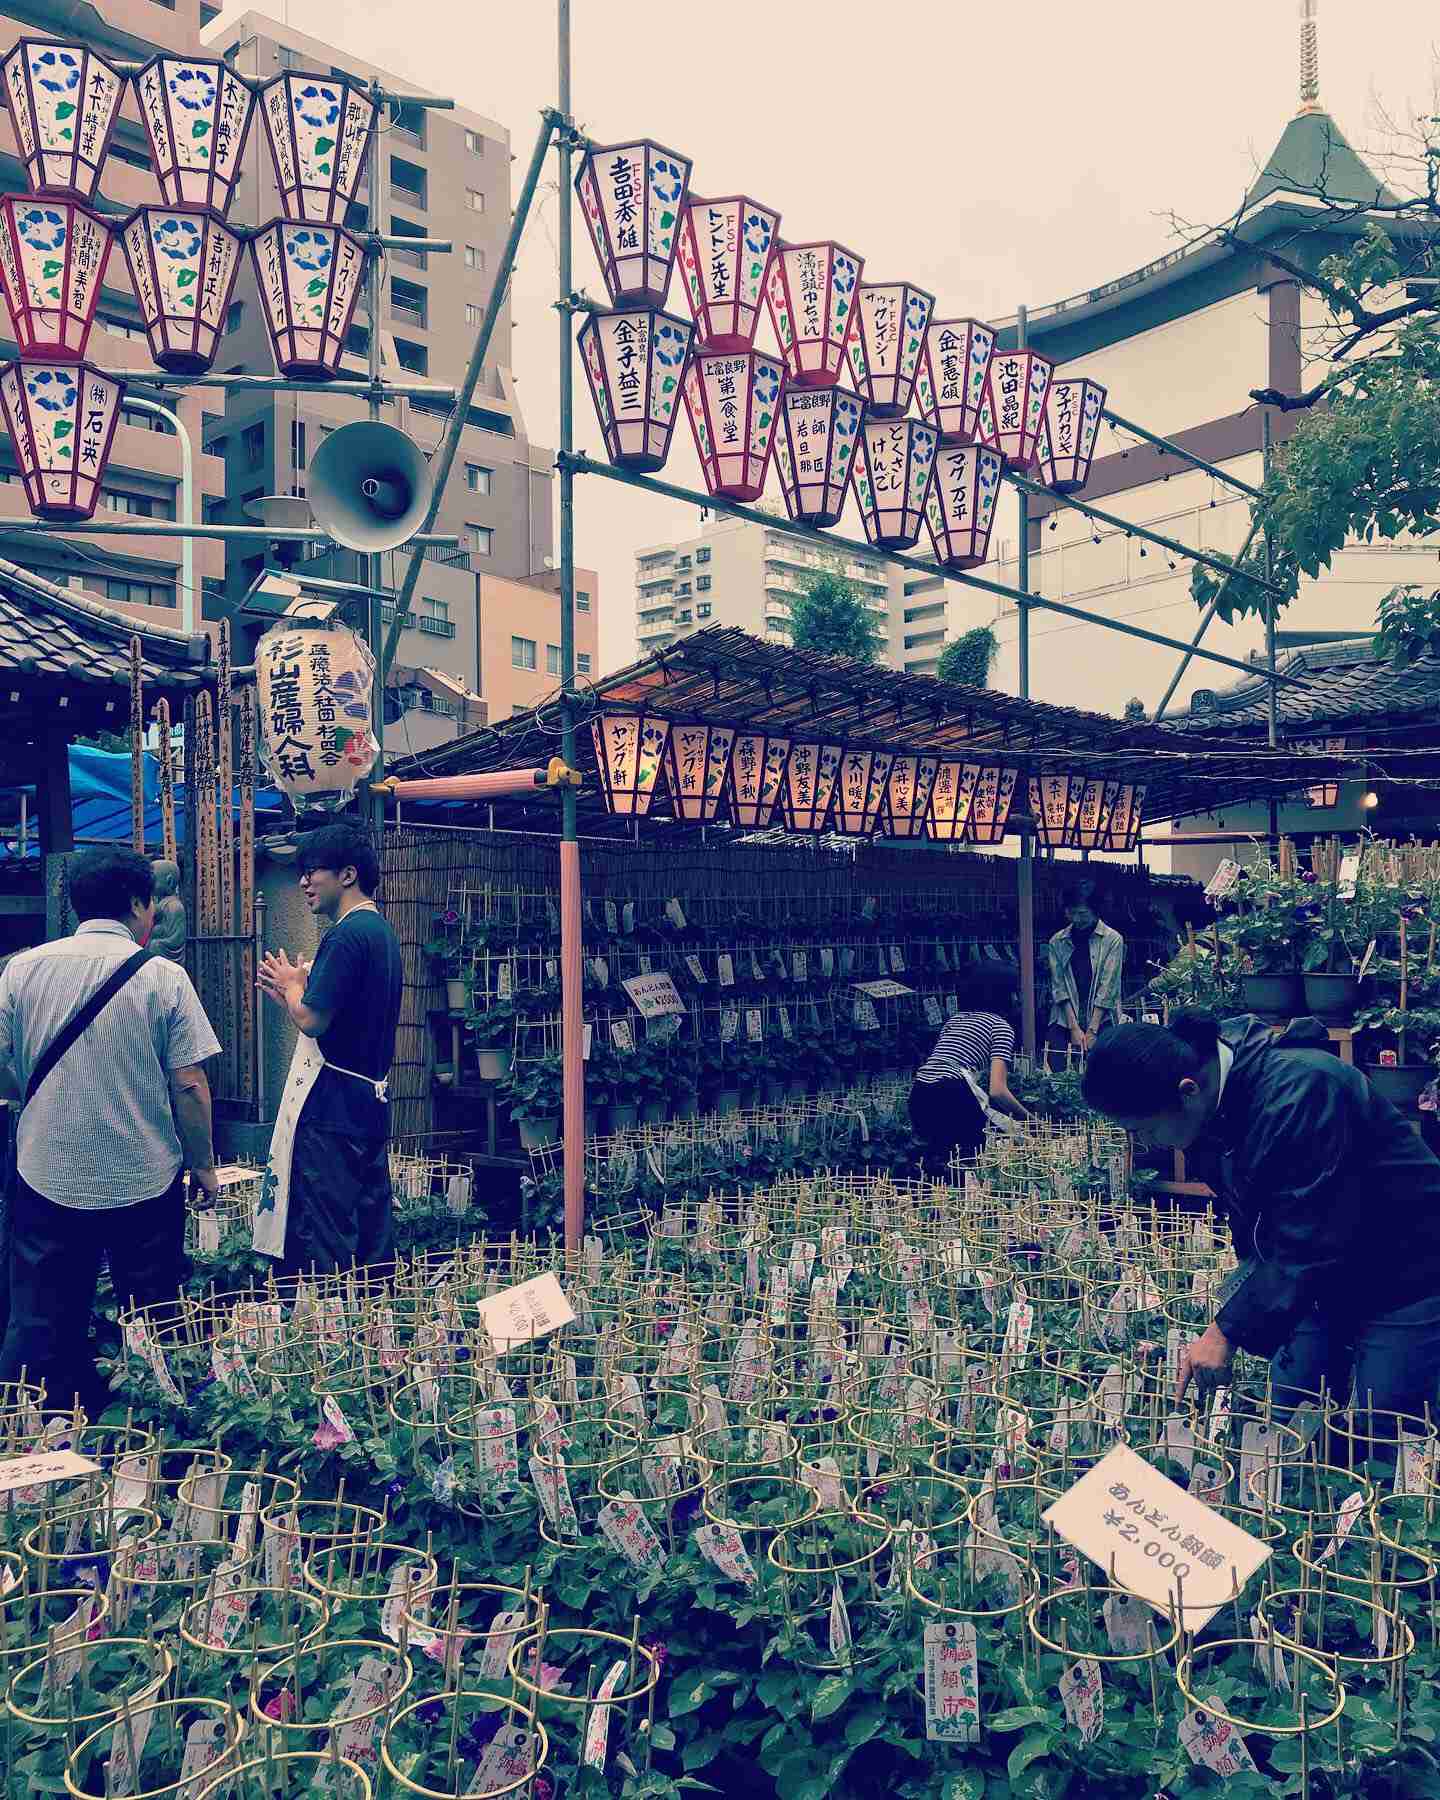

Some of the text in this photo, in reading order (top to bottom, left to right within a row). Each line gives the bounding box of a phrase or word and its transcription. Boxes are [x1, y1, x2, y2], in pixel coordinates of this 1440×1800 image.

[216, 78, 238, 164] 木下典子
[609, 156, 640, 250] 吉田秀雄
[632, 163, 642, 205] FSC
[200, 233, 225, 316] 吉村正人
[708, 208, 730, 300] トントン先生
[612, 319, 642, 411] 金子益三
[704, 359, 747, 377] 上富良野
[718, 376, 739, 444] 第一食堂
[872, 437, 889, 491] けんご
[889, 426, 904, 490] とくさし
[946, 452, 969, 521] マグ万平
[265, 636, 316, 782] 杉山産婦人科
[1102, 1508, 1191, 1578] ¥2,000
[1108, 1482, 1225, 1571] あんどん朝顔
